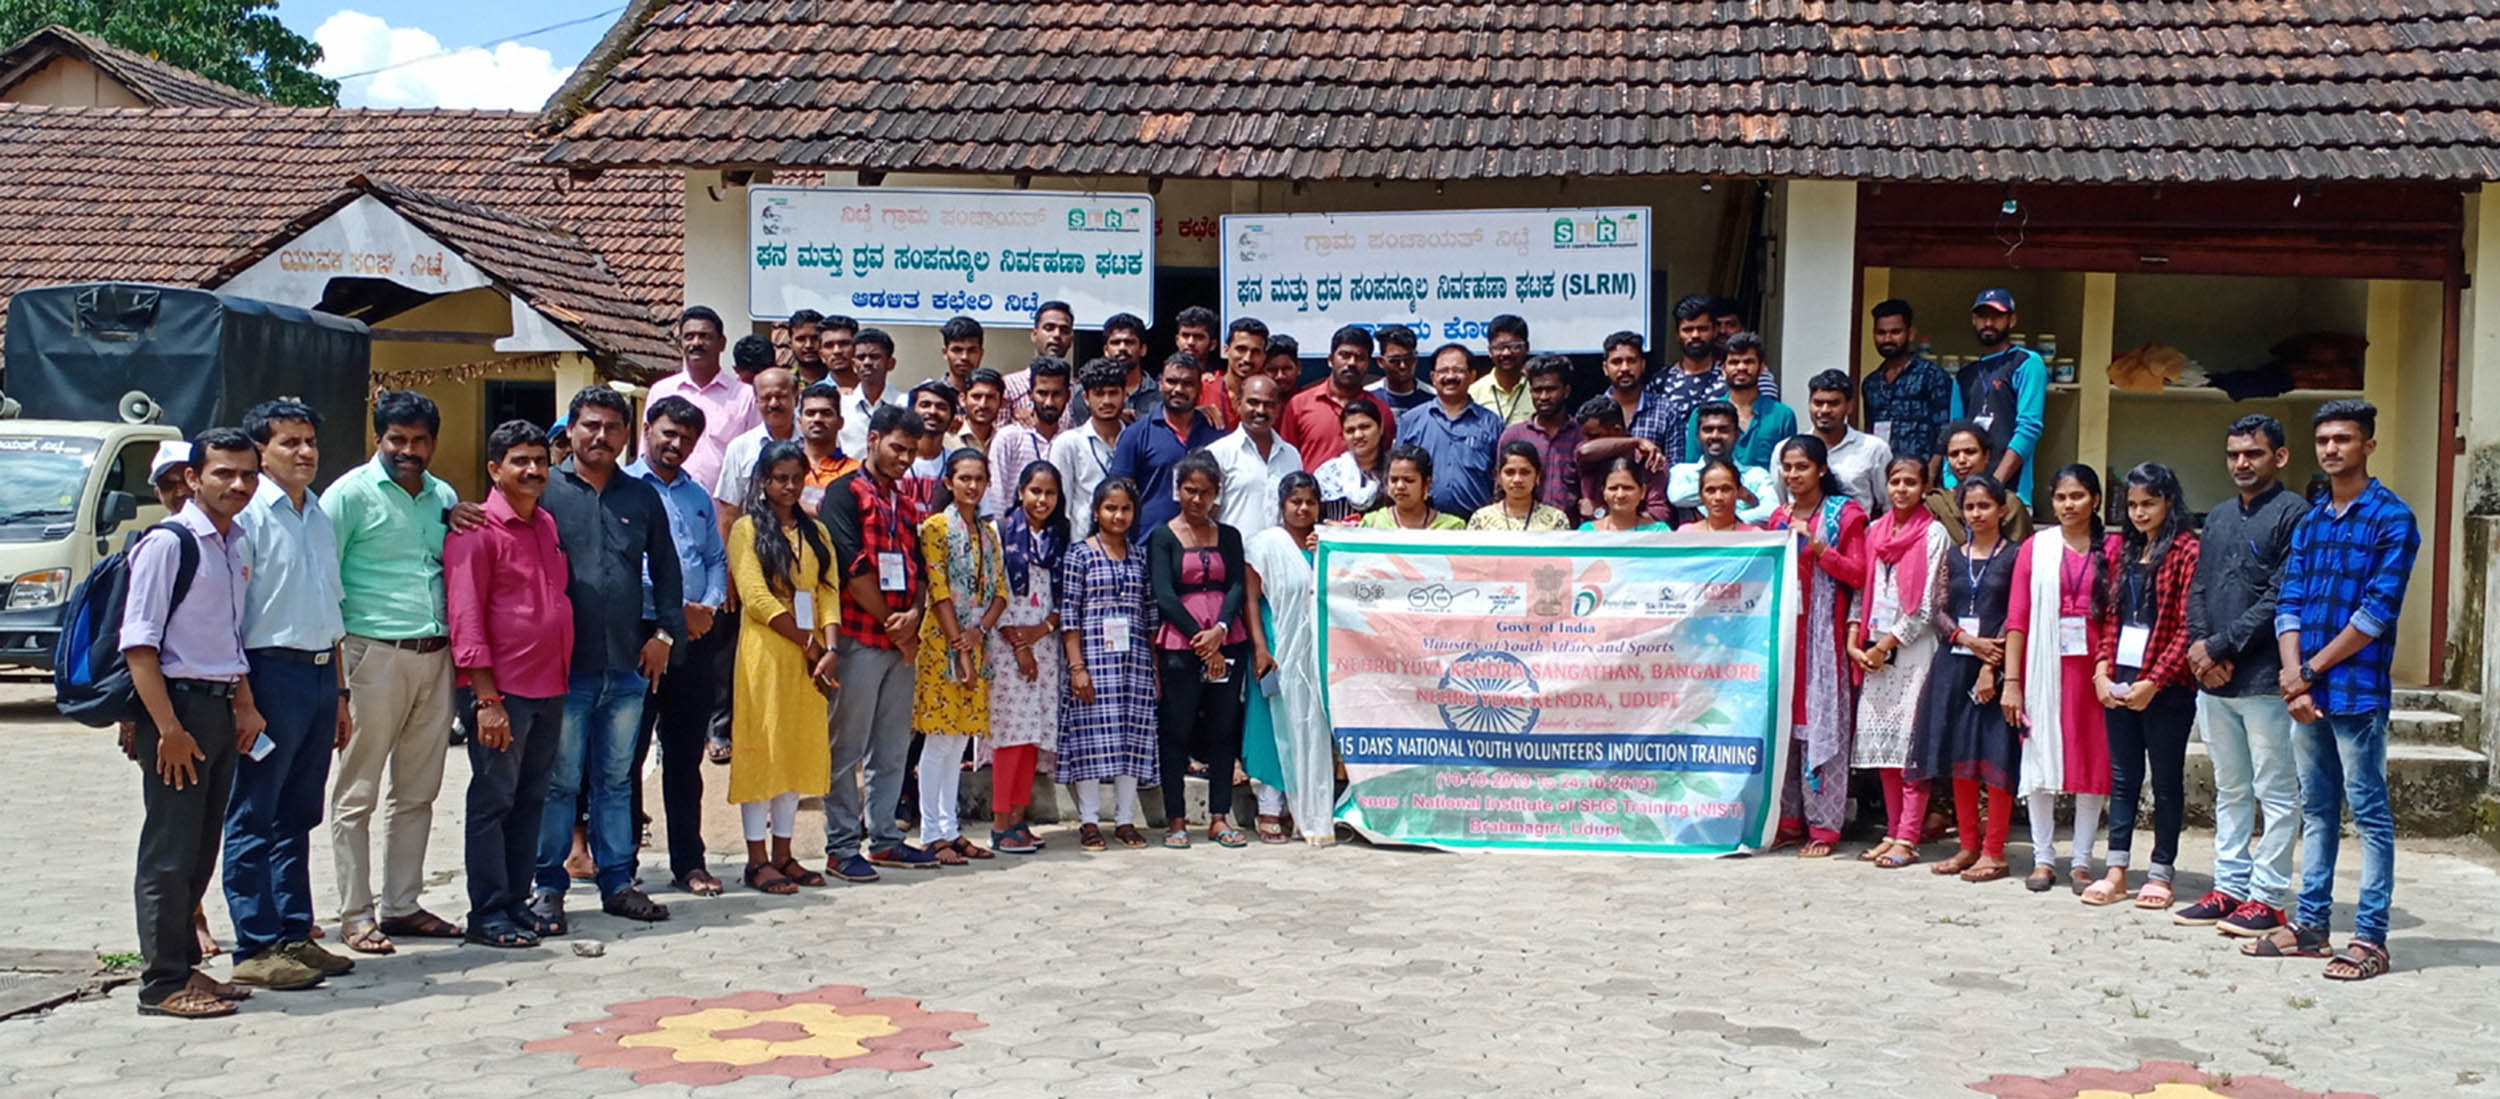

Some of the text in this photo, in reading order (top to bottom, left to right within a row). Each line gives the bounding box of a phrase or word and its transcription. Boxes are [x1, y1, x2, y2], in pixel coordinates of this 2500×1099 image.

[797, 241, 843, 277] ಮತ್ತು
[852, 242, 885, 278] ದ್ರವ
[1270, 272, 1309, 312] ಮತ್ತು
[1316, 271, 1342, 312] ದ್ರವ
[1562, 272, 1637, 301] (SLRM)
[1540, 621, 1554, 633] of
[1559, 621, 1596, 633] India
[1421, 637, 1480, 655] Ministry
[1484, 638, 1501, 652] of
[1503, 639, 1544, 653] Youth
[1597, 640, 1624, 653] and
[1627, 641, 1675, 656] Sports
[1335, 657, 1761, 681] NEHRU YUVA KENDRA SANGATHAN, BANGALORE
[1416, 688, 1679, 711] NEHRU YUVA KENDRA, UDUPI
[1338, 736, 1757, 766] 15 DAYS NATIONAL YOUTH VOLUNTEERS INDUCTION TRAINING
[1536, 774, 1556, 790] To
[1357, 793, 1400, 809] enue
[1412, 793, 1482, 811] National
[1485, 794, 1553, 812] Institute
[1557, 799, 1576, 812] of
[1579, 799, 1617, 813] SHG
[1622, 799, 1690, 818] Training
[1694, 801, 1745, 818] (NIST)
[1570, 823, 1622, 838] Udupi
